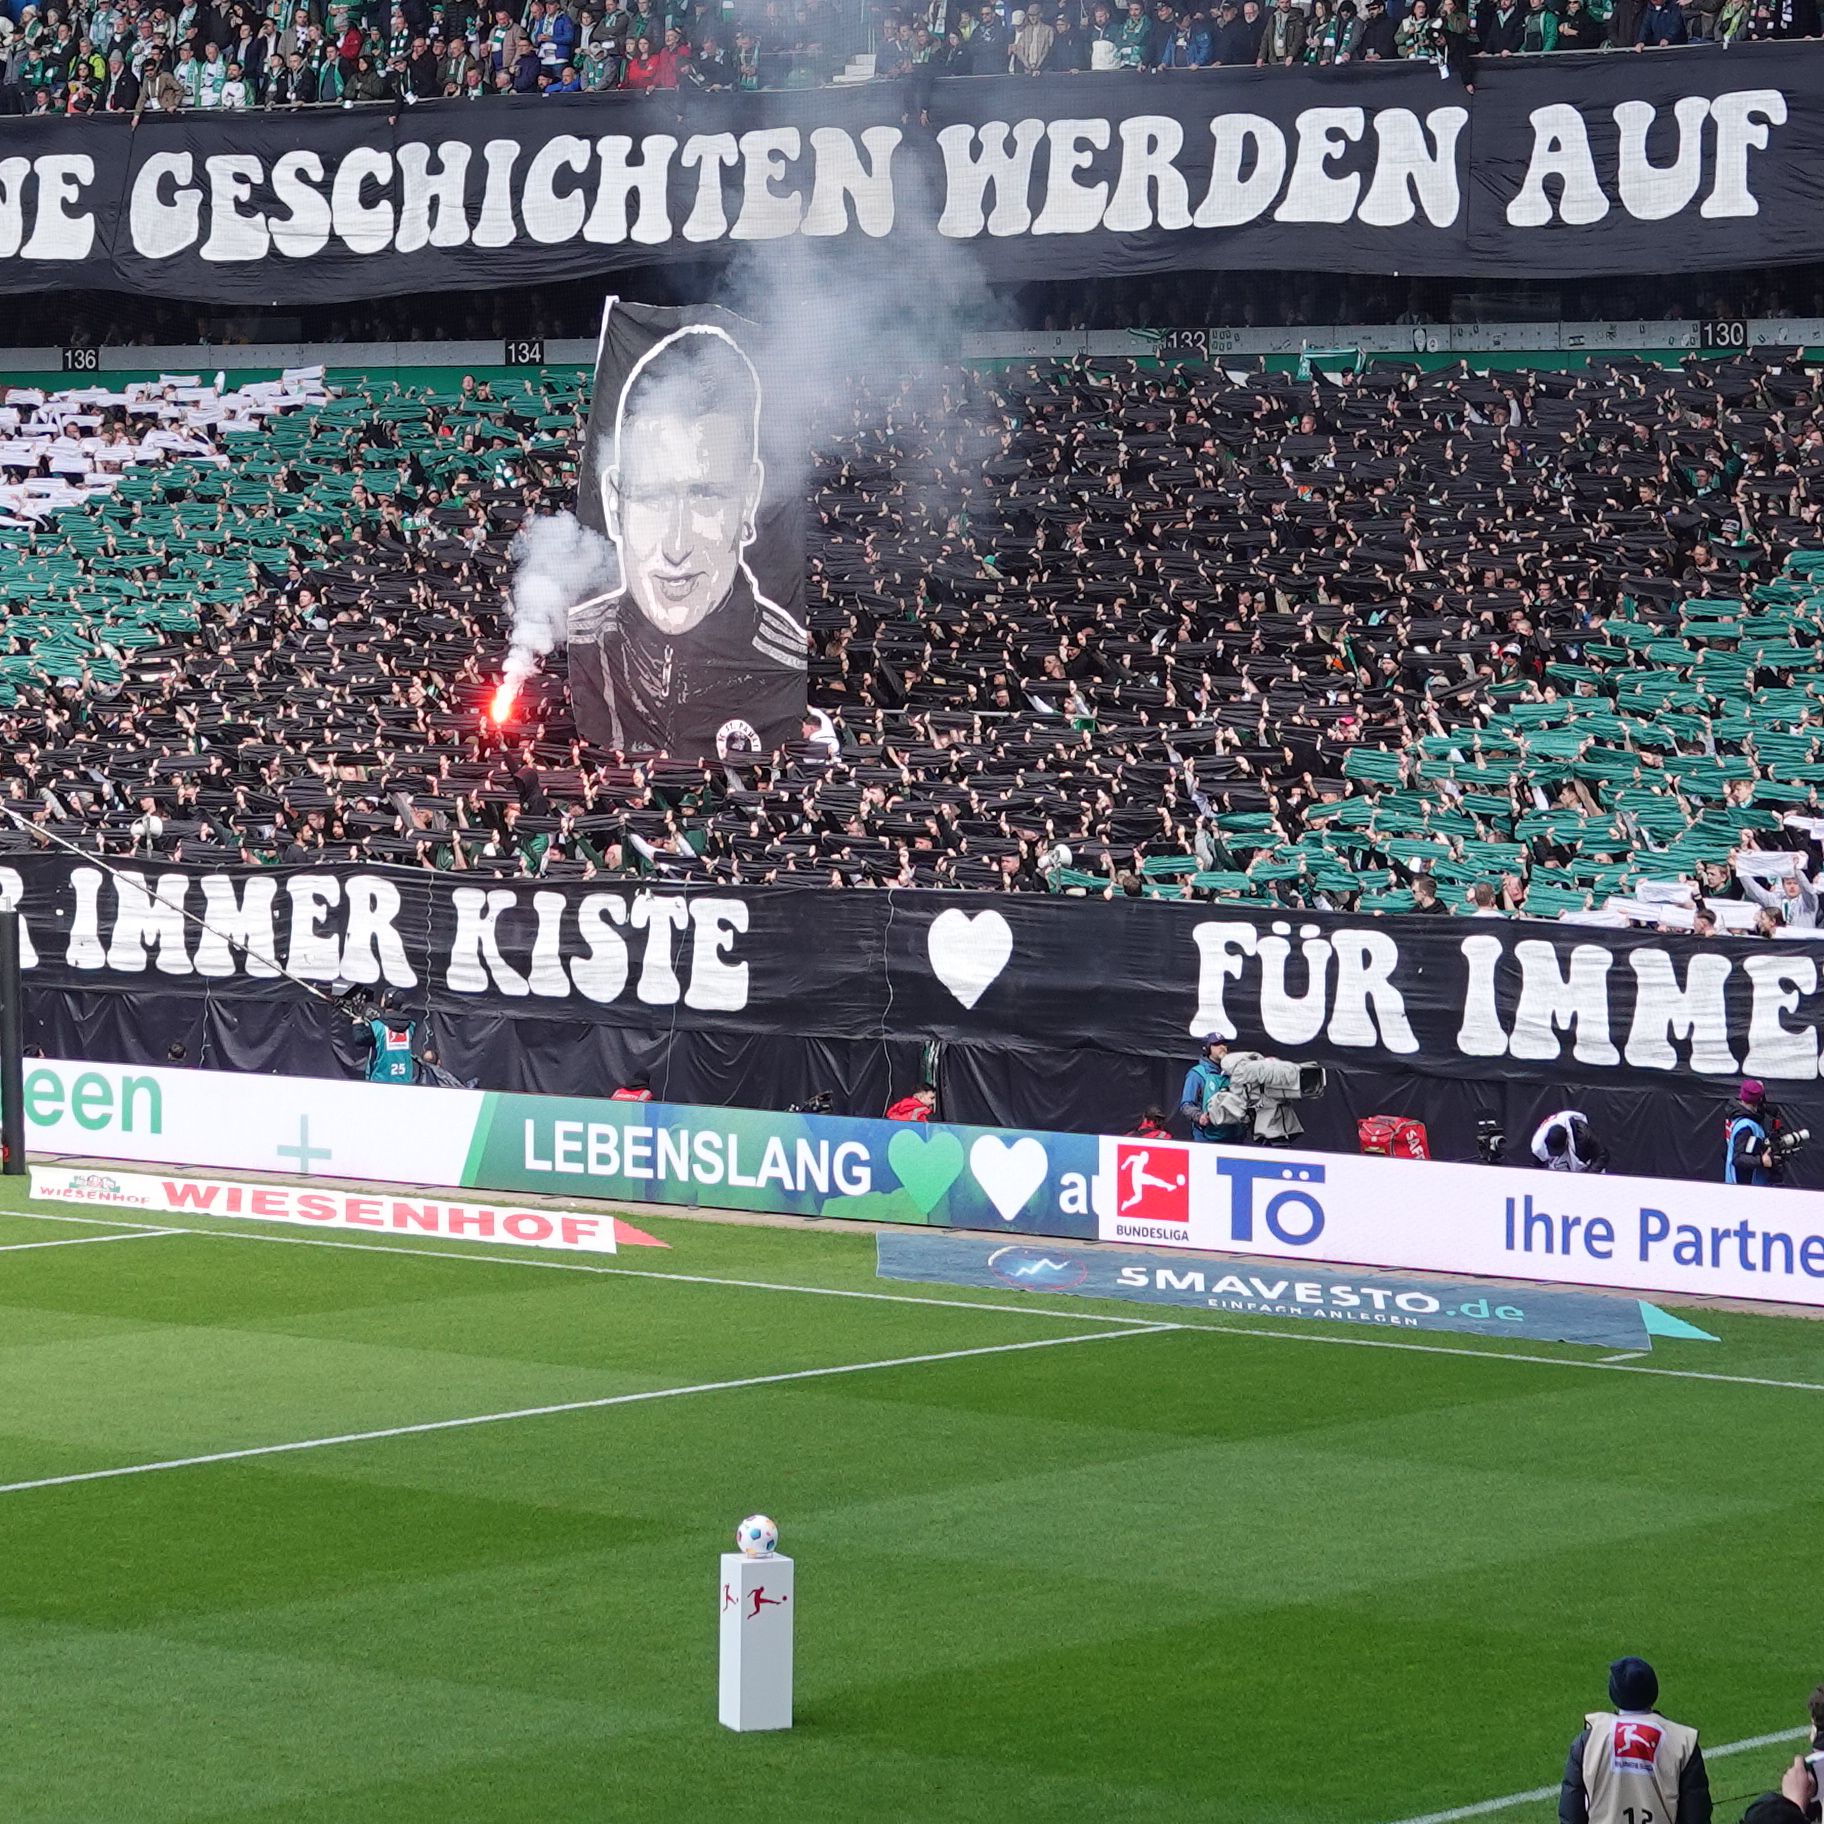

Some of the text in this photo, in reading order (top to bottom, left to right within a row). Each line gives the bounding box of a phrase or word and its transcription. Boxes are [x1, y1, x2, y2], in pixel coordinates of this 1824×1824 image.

[128, 126, 900, 262] GESCHICHTEN
[937, 106, 1469, 239] WERDEN
[1506, 89, 1788, 229] AUF
[508, 343, 542, 363] 134
[1703, 322, 1745, 347] 130
[65, 349, 97, 370] 136
[66, 867, 418, 989] IMMER
[446, 884, 750, 1012] KISTE
[1188, 920, 1421, 1054] FÜR
[391, 1063, 406, 1076] 25
[524, 1119, 872, 1197] LEBENSLANG
[40, 1186, 151, 1205] WIESENHOF
[162, 1180, 619, 1246] WIESENHOF
[1115, 1224, 1190, 1242] BUNDESLIGA
[1504, 1193, 1614, 1259] Ihre
[1117, 1265, 1525, 1323] SMAVESTO.de
[1207, 1297, 1419, 1327] EINFACH ANLEGEN
